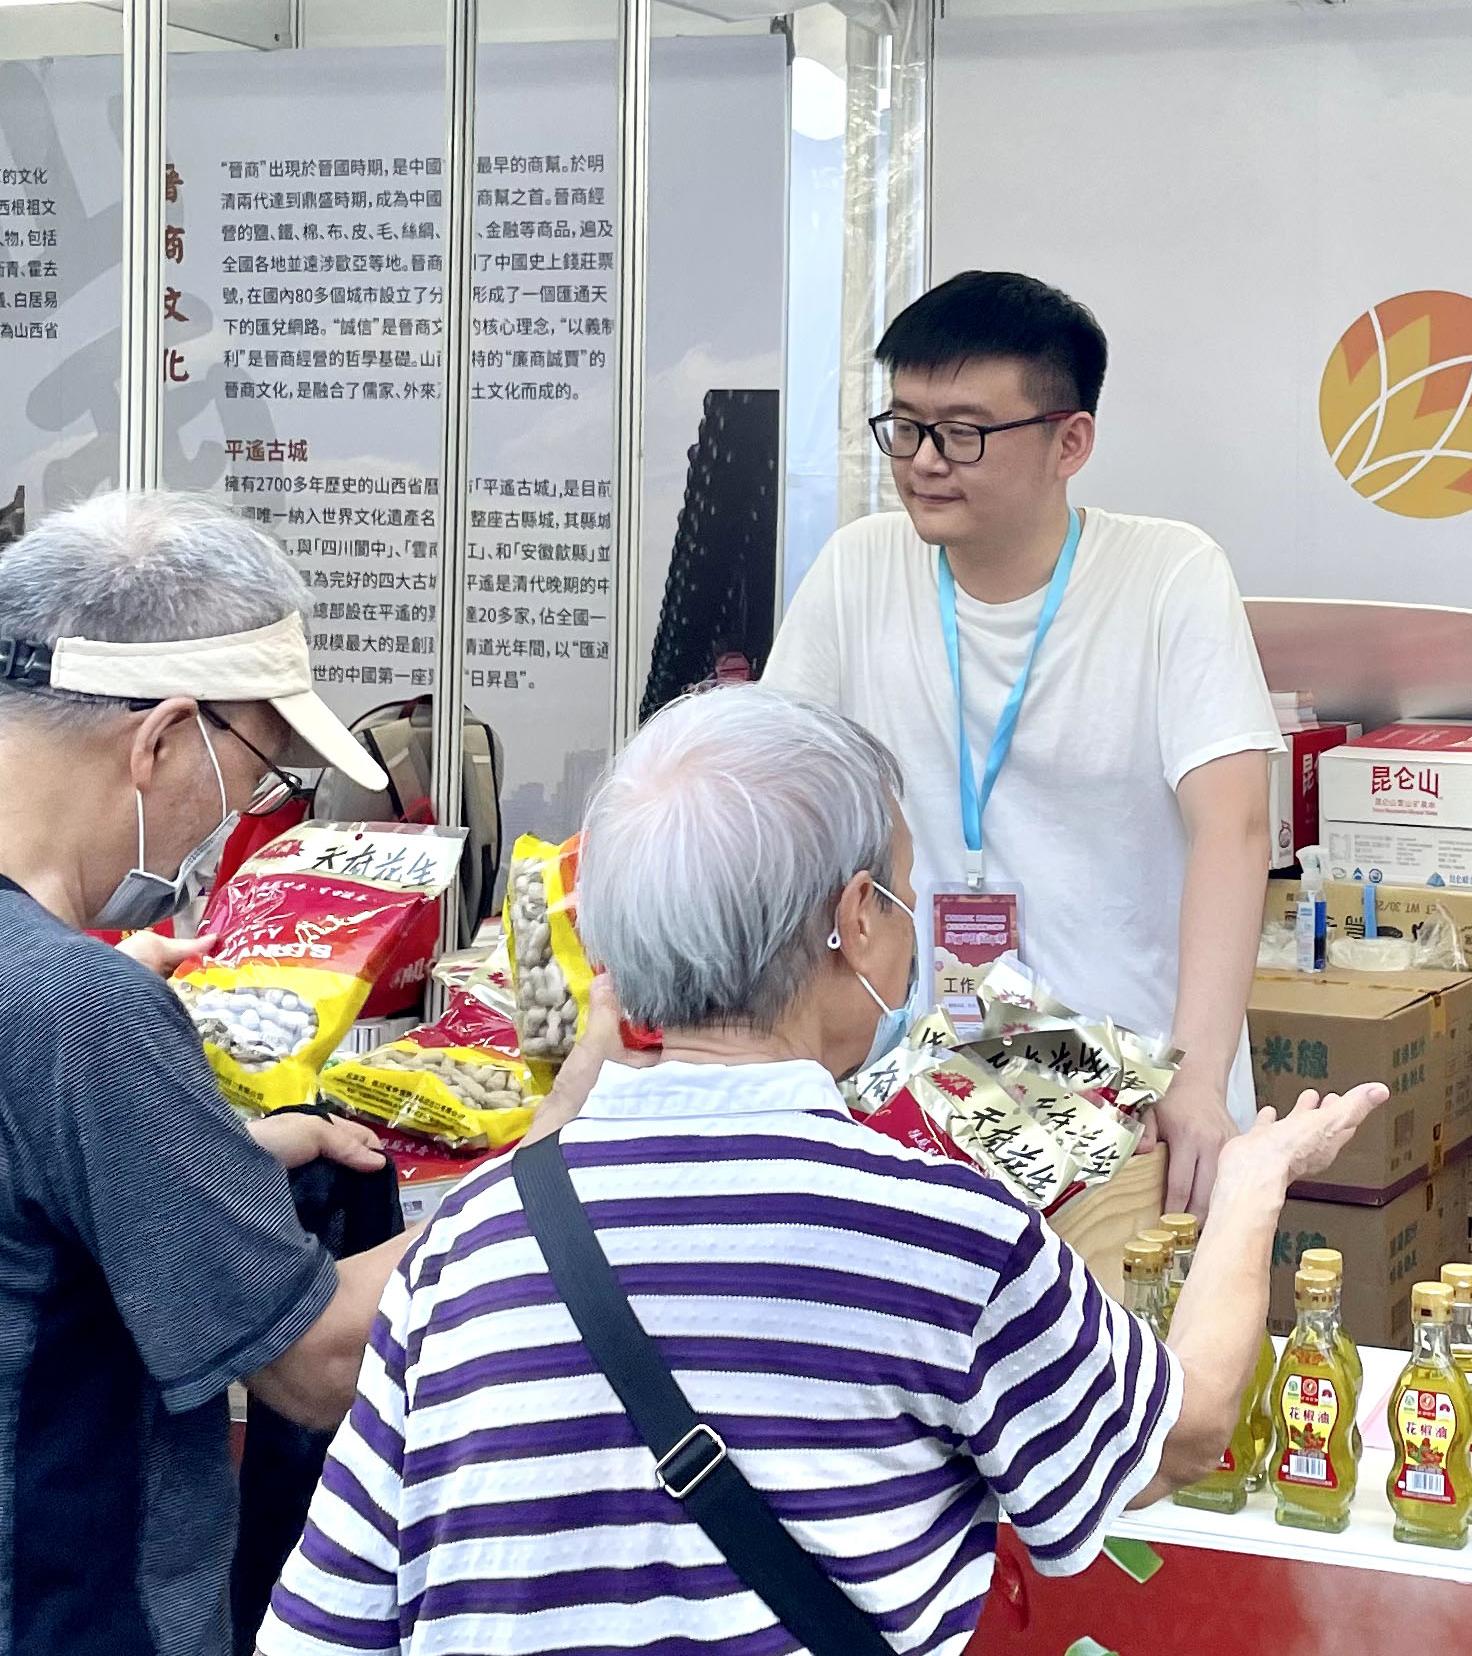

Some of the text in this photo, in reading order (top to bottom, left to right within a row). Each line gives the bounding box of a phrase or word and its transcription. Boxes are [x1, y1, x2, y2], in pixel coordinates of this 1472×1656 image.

[0, 168, 48, 186] 的文化
[225, 438, 309, 462] 平遙古城
[1371, 765, 1439, 799] 昆仑山
[311, 843, 438, 889] 天府花生
[1289, 1405, 1331, 1426] 花椒油
[1406, 1420, 1449, 1440] 花椒油
